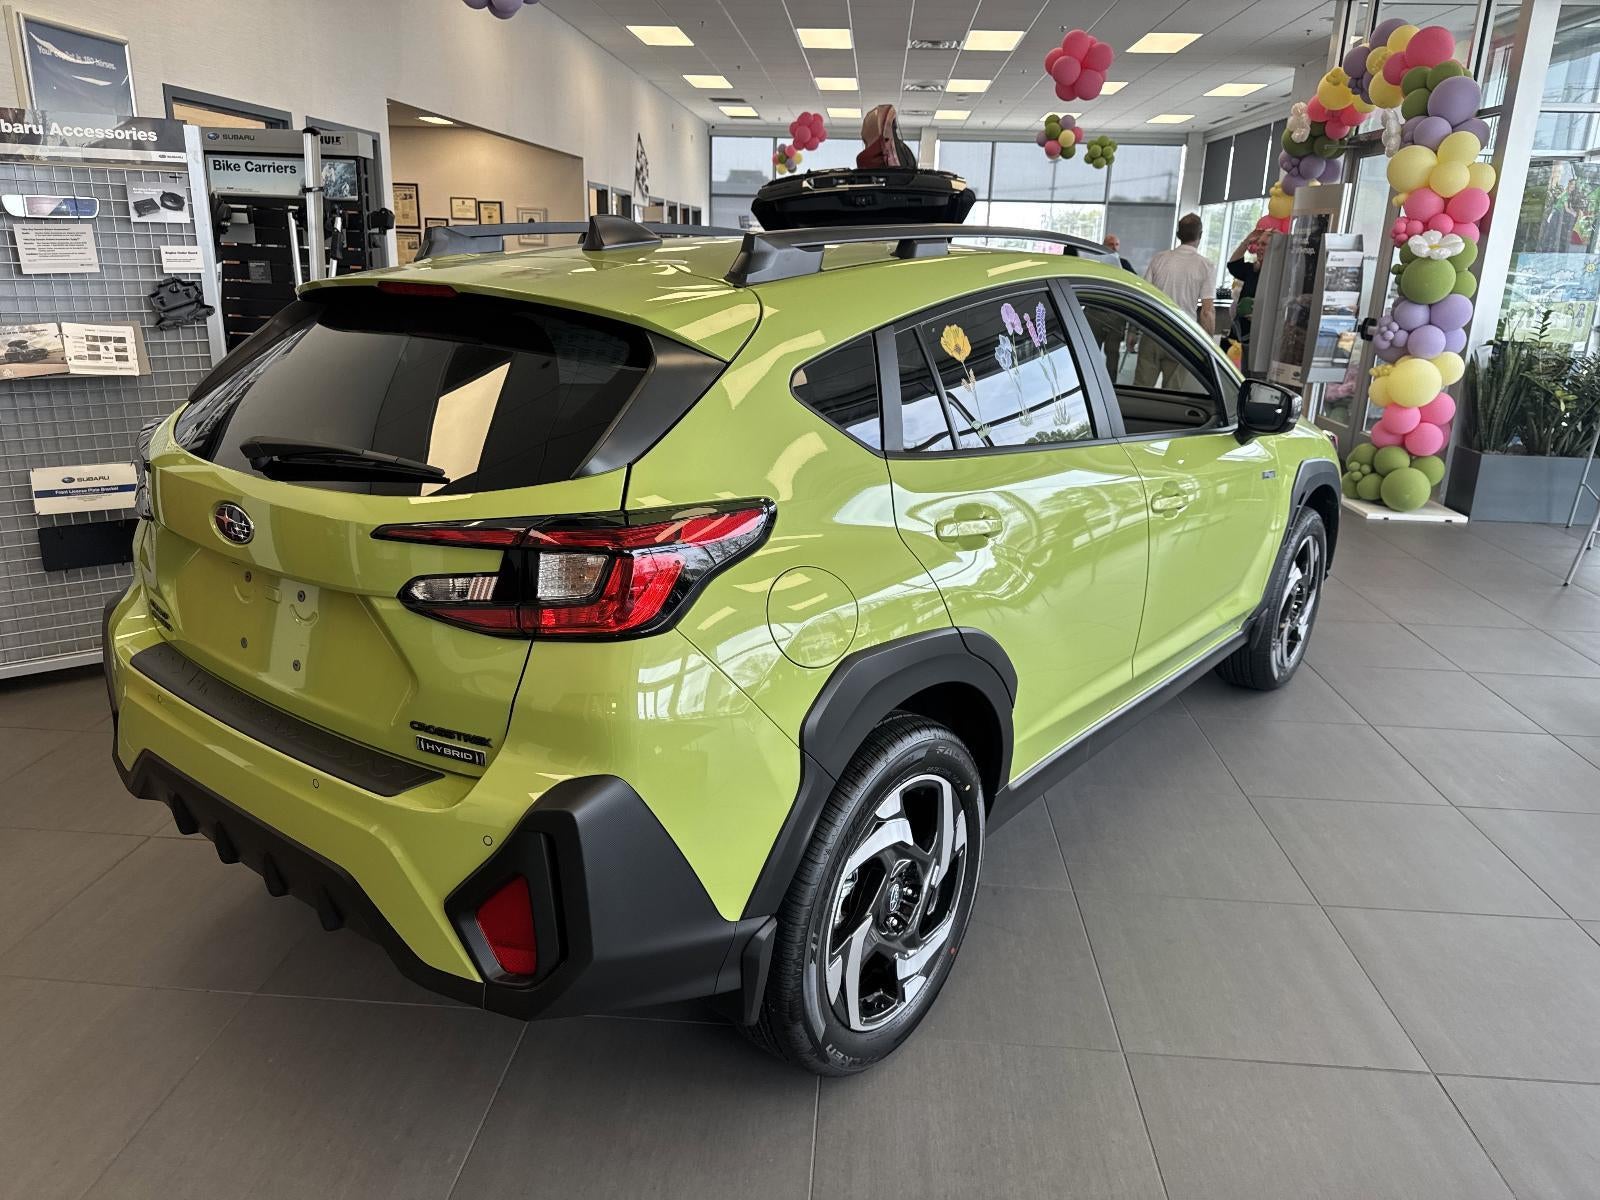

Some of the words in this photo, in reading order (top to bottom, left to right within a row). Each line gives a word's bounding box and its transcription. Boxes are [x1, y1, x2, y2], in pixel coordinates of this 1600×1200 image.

[0, 119, 44, 134] baru
[49, 122, 158, 142] Accessories
[213, 159, 241, 172] Bike
[244, 160, 297, 174] Carriers
[426, 742, 473, 761] HYBRID
